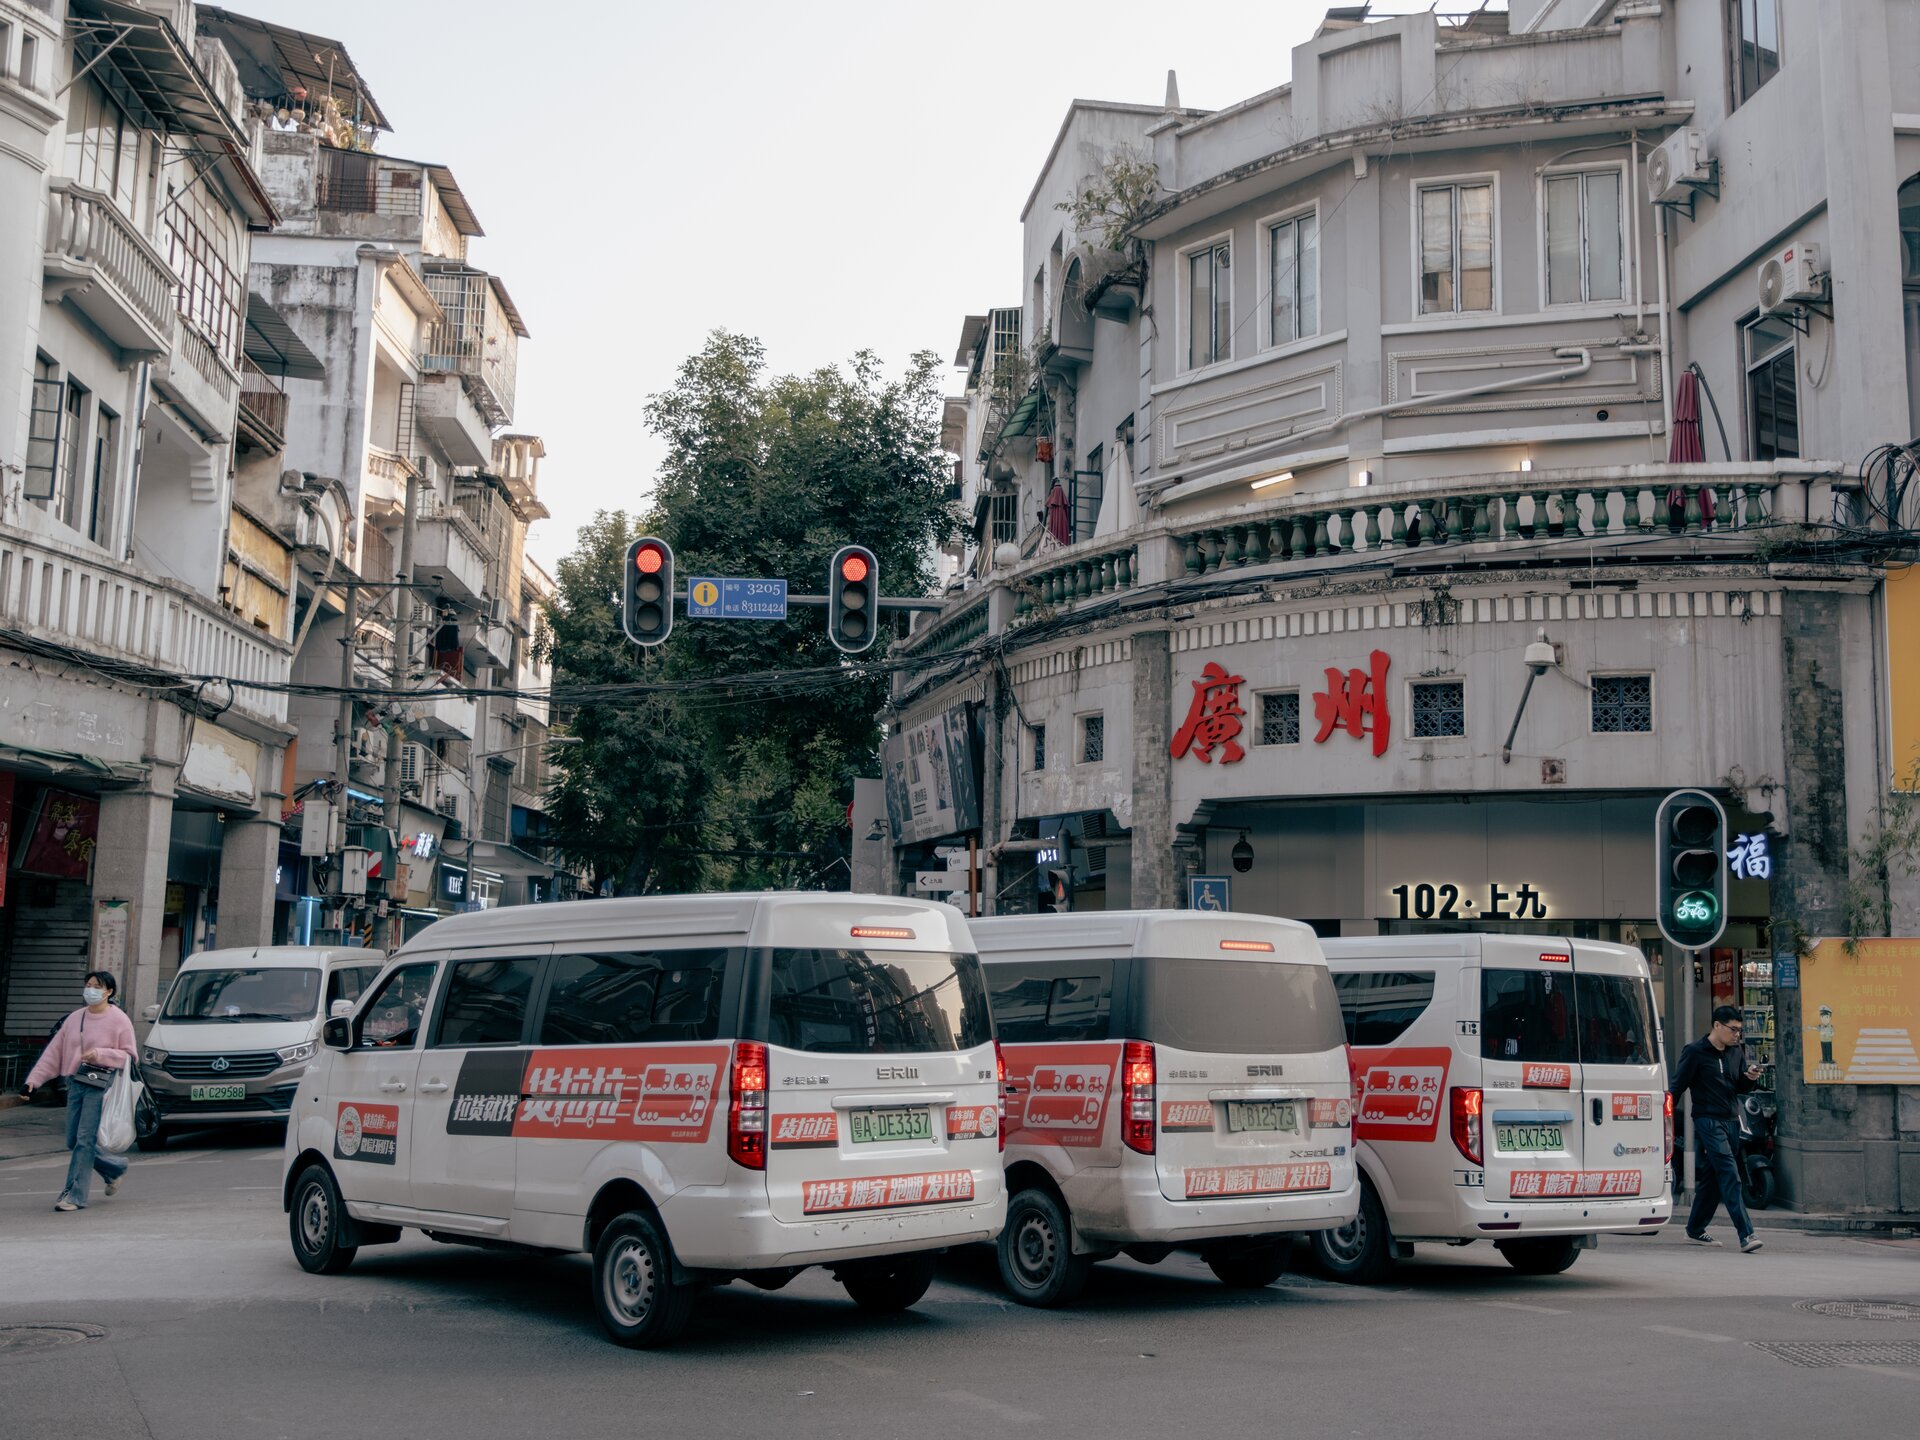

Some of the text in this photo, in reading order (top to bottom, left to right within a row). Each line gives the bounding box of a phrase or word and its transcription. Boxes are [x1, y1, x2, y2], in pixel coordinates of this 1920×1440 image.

[747, 583, 781, 596] 3205
[694, 607, 717, 615] 交通灯
[725, 600, 784, 615] 电话 83112424
[1169, 648, 1391, 765] 廣州
[1727, 833, 1771, 880] 福
[1849, 984, 1897, 997] 文明出行
[877, 1066, 919, 1080] SRM
[1247, 1065, 1283, 1076] SRM
[1526, 1066, 1566, 1085] 货拉拉
[208, 1087, 244, 1098] C29588
[453, 1094, 519, 1123] 拉货就找
[1167, 1104, 1212, 1125] 货拉拉
[776, 1116, 835, 1140] 货拉拉
[879, 1113, 930, 1137] DE3337
[1519, 1129, 1562, 1147] CK7530
[1187, 1164, 1331, 1194] 拉货 搬家 跑腿 发长途
[1510, 1171, 1642, 1195] 拉货 搬家 跑腿 发长途
[805, 1172, 972, 1210] 拉货 搬家 跑腿 发长途
